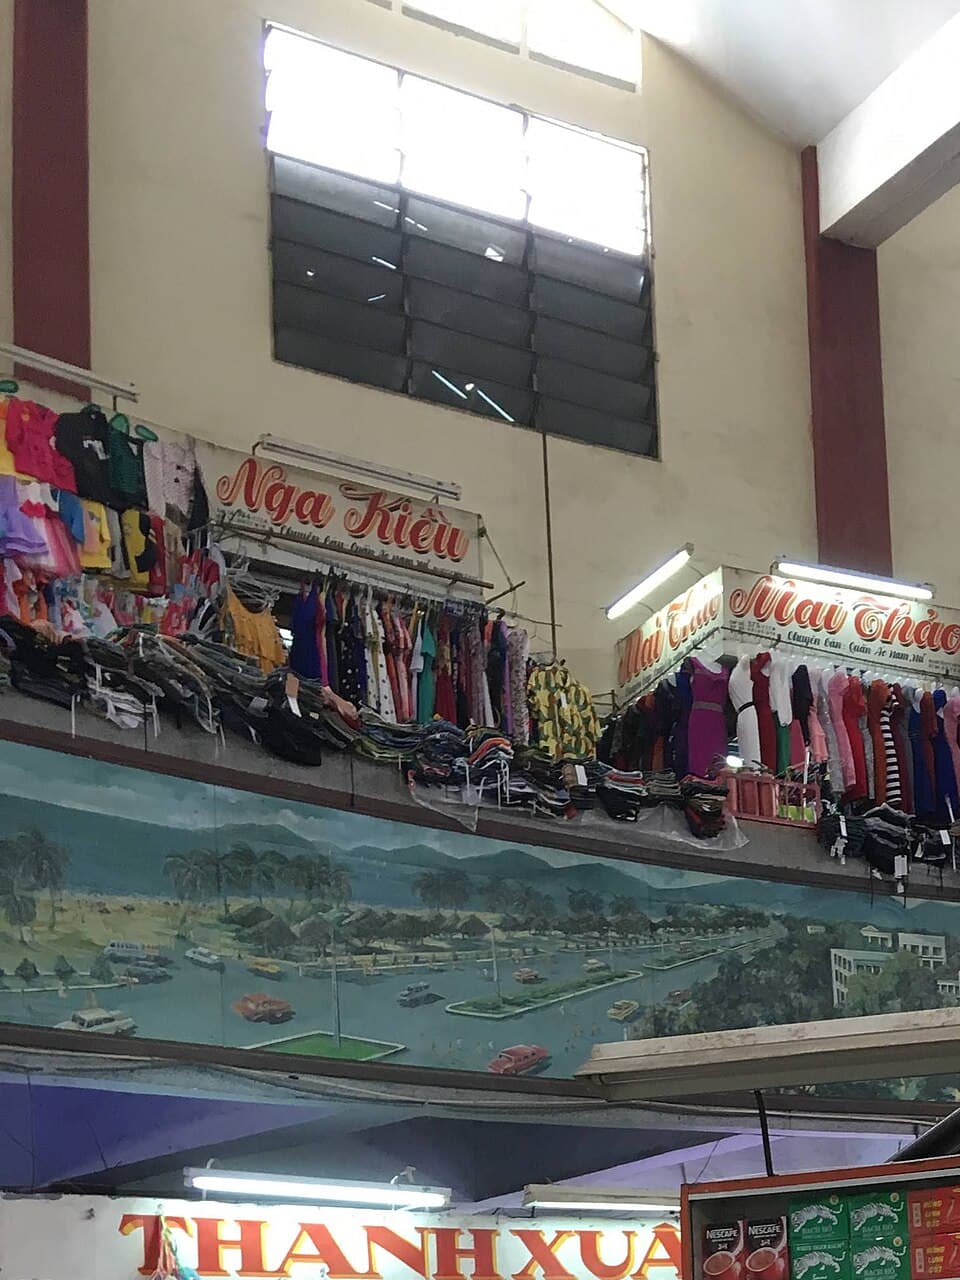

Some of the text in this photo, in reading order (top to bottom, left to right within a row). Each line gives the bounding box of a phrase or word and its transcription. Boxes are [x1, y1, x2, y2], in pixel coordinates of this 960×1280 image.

[216, 457, 336, 529] Nga
[729, 574, 849, 634] Mai
[118, 1213, 683, 1280] THANH XUÂ
